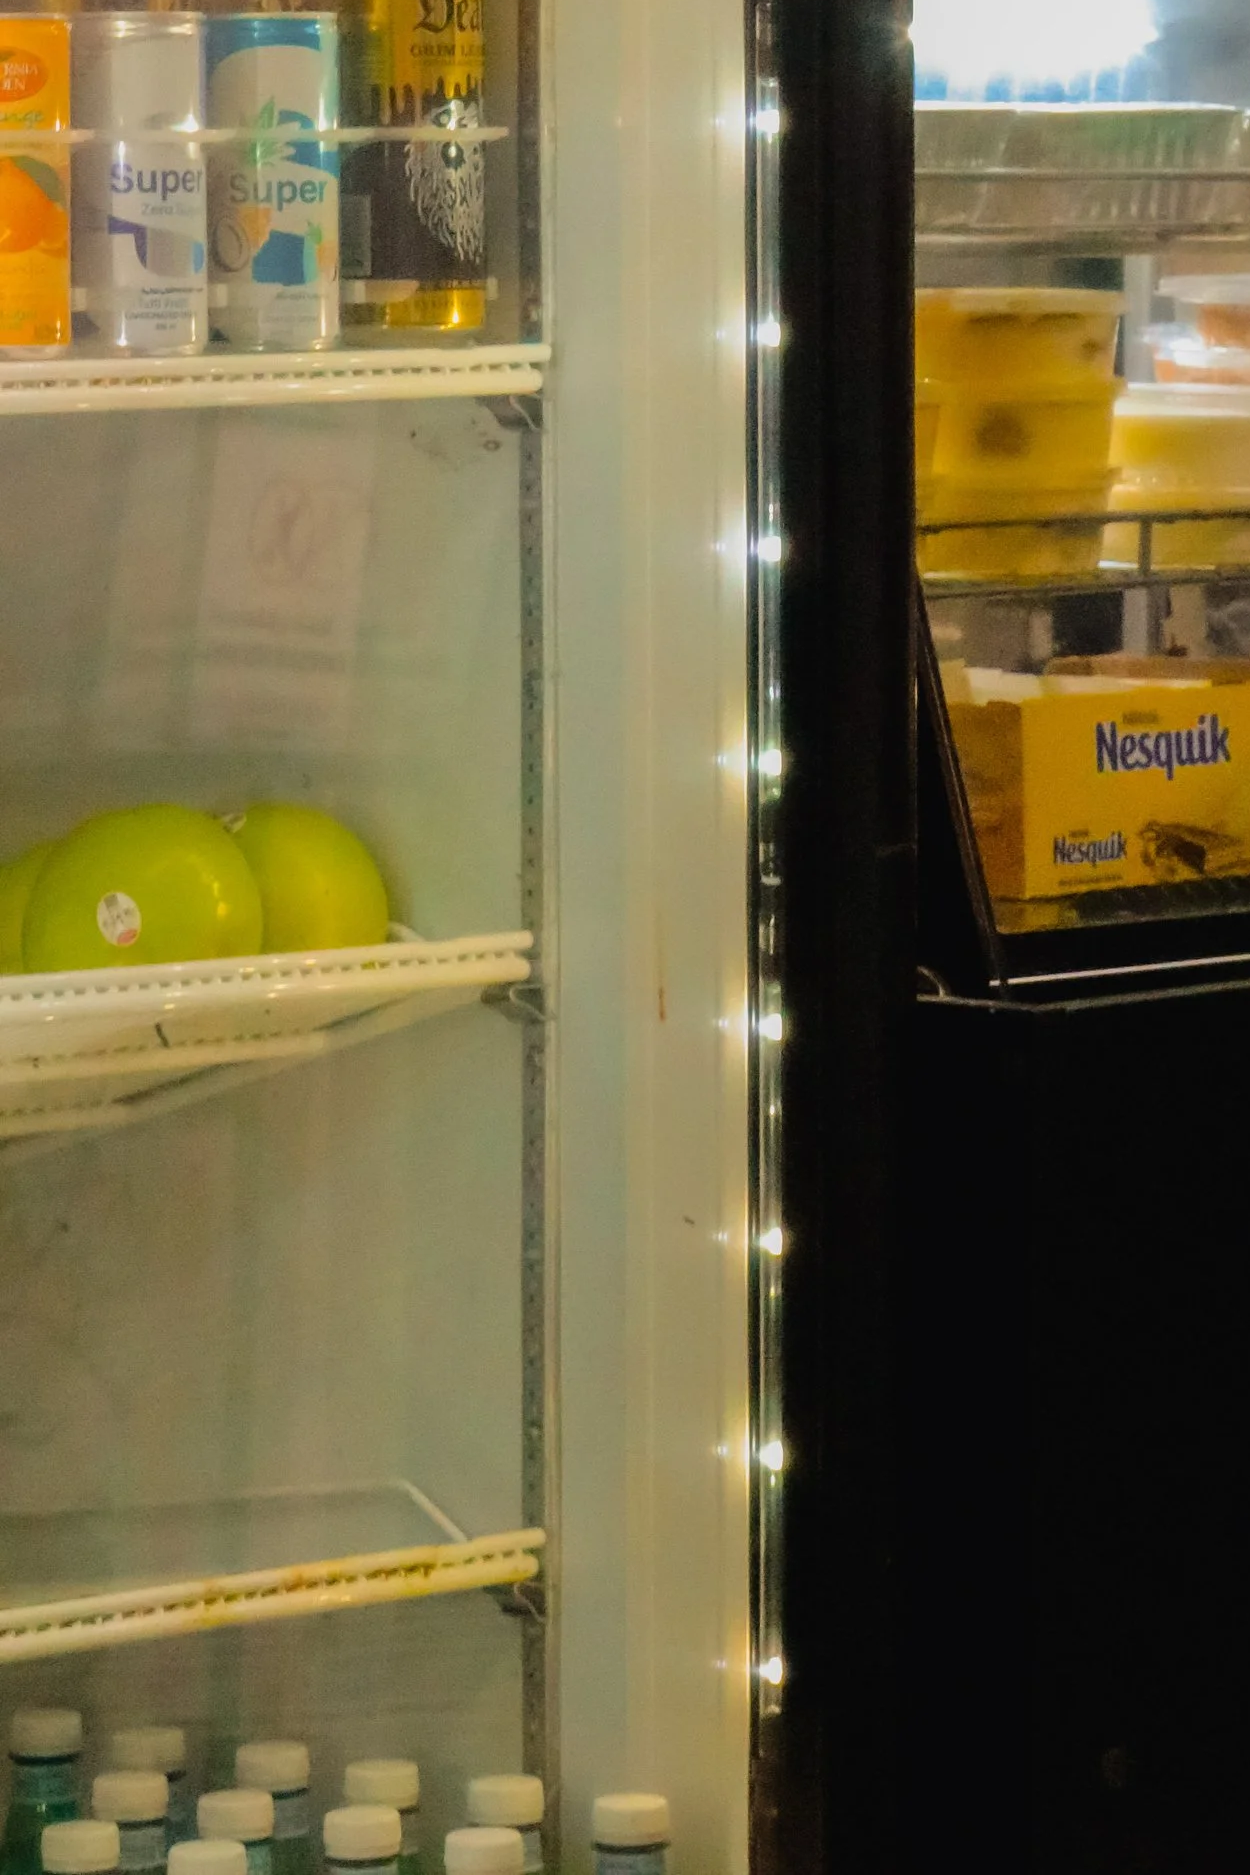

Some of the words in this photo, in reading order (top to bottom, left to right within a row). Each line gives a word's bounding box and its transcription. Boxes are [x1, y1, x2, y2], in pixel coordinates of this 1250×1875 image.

[110, 163, 203, 201] Super
[229, 172, 328, 212] Super
[1095, 712, 1232, 782] Nesquik
[1052, 831, 1128, 869] Nesquik
